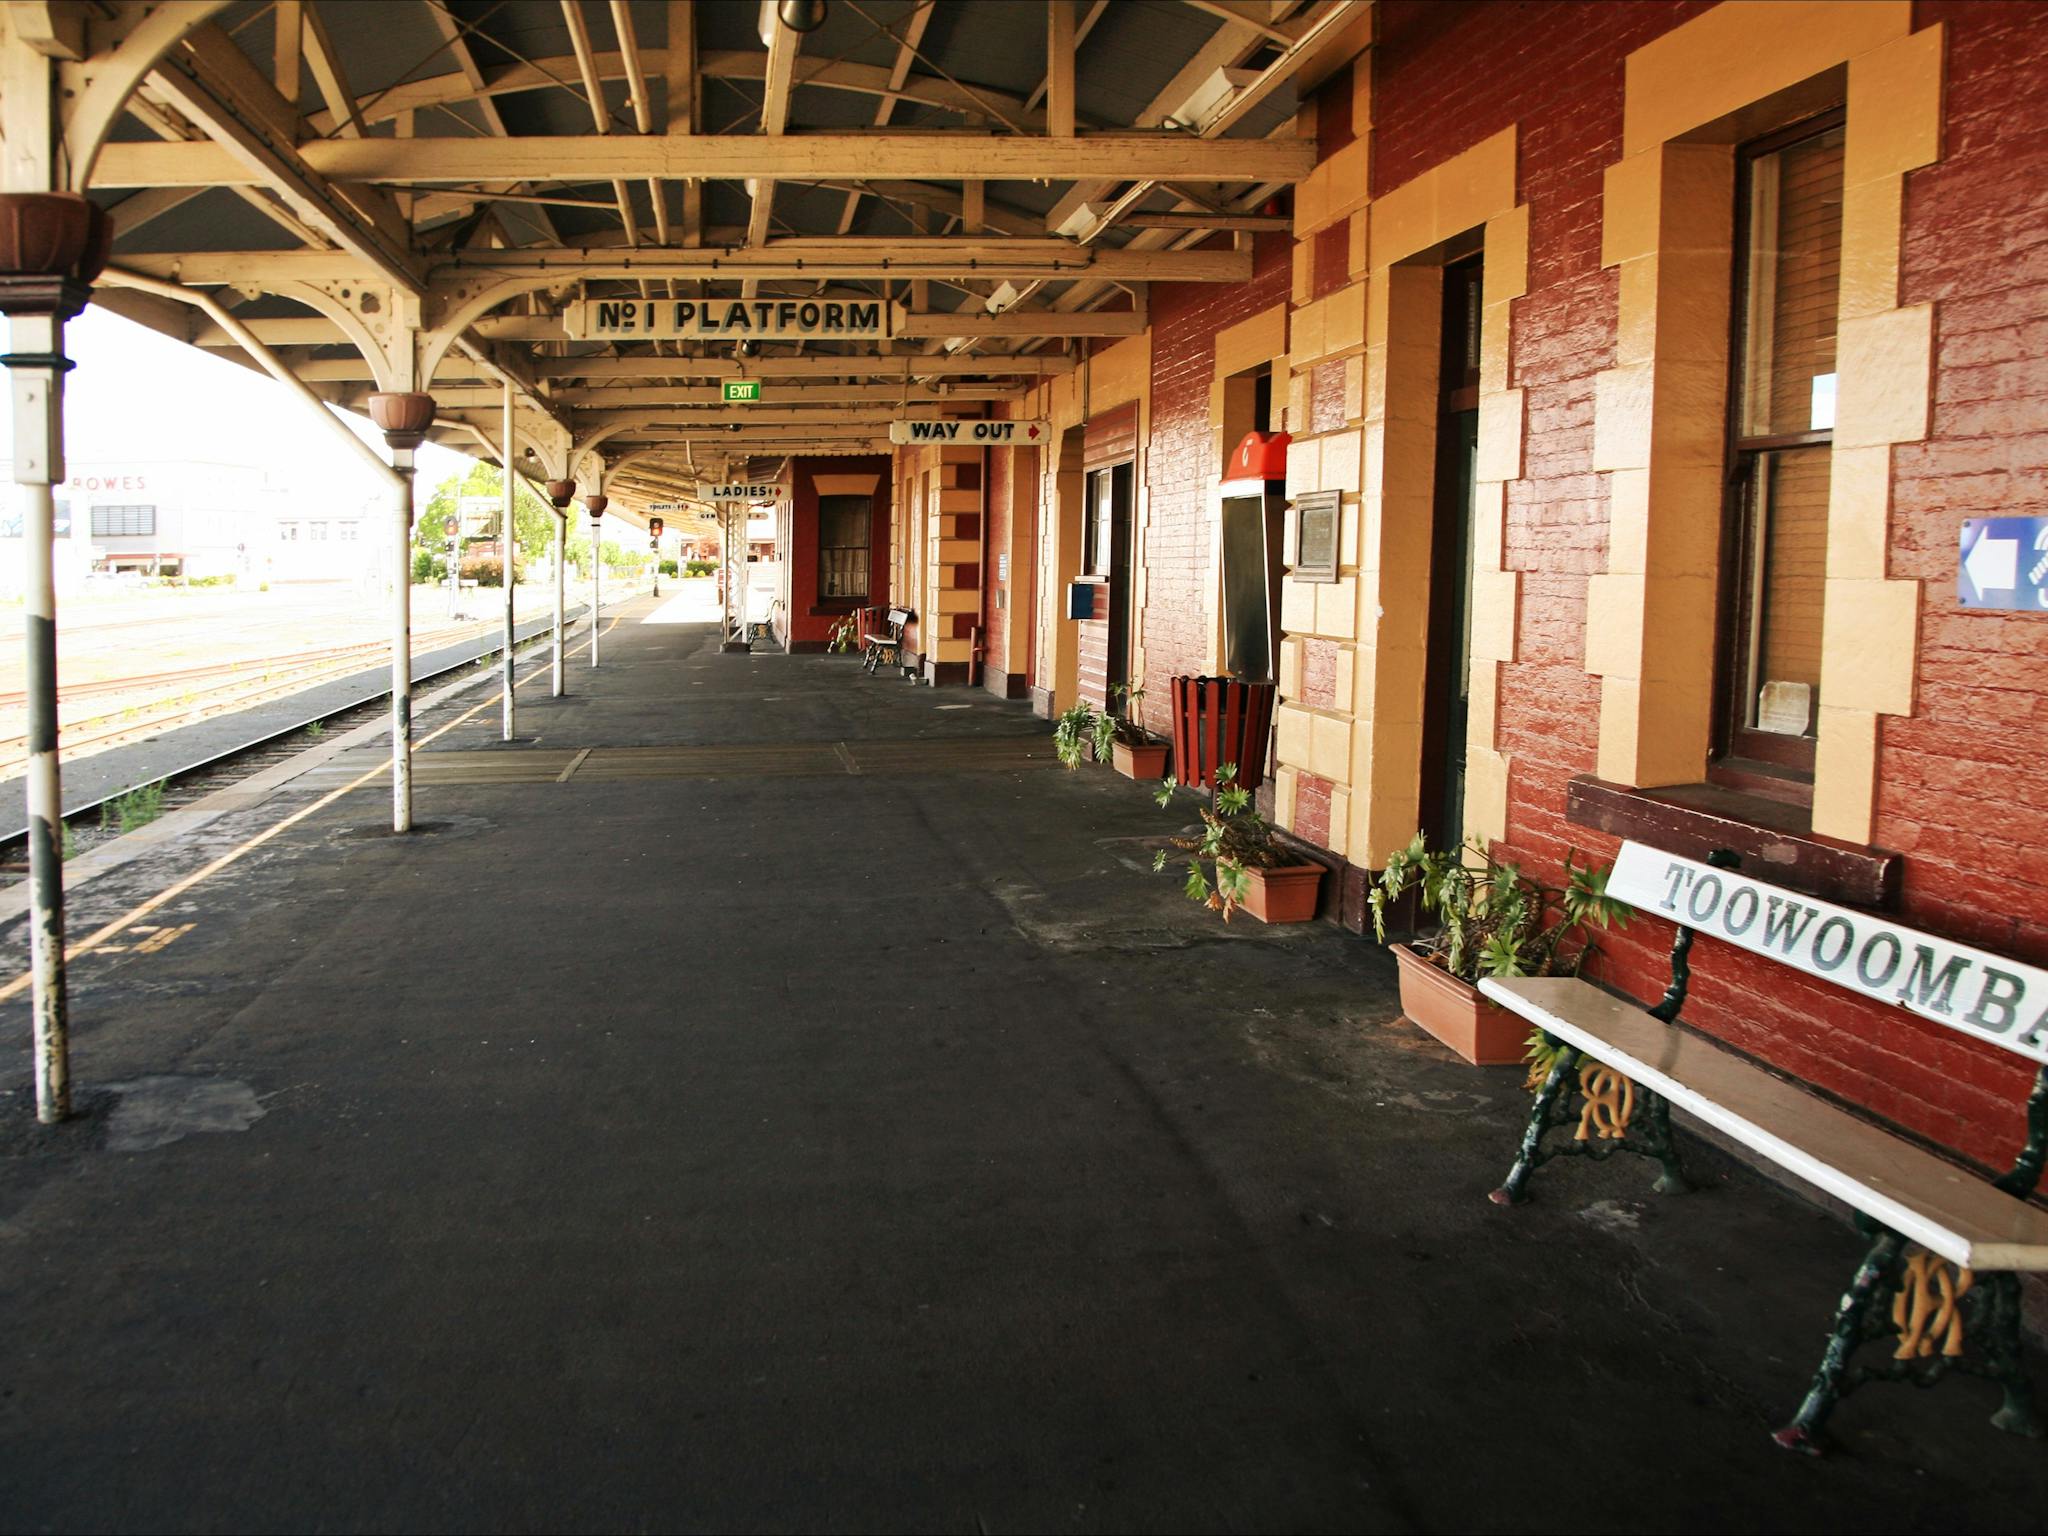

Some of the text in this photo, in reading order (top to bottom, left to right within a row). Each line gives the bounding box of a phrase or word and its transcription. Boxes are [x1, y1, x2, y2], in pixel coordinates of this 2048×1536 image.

[676, 302, 879, 332] PLATFORM
[729, 385, 753, 399] EXIT
[911, 423, 1014, 439] WAY OUT
[713, 486, 767, 497] LADIES
